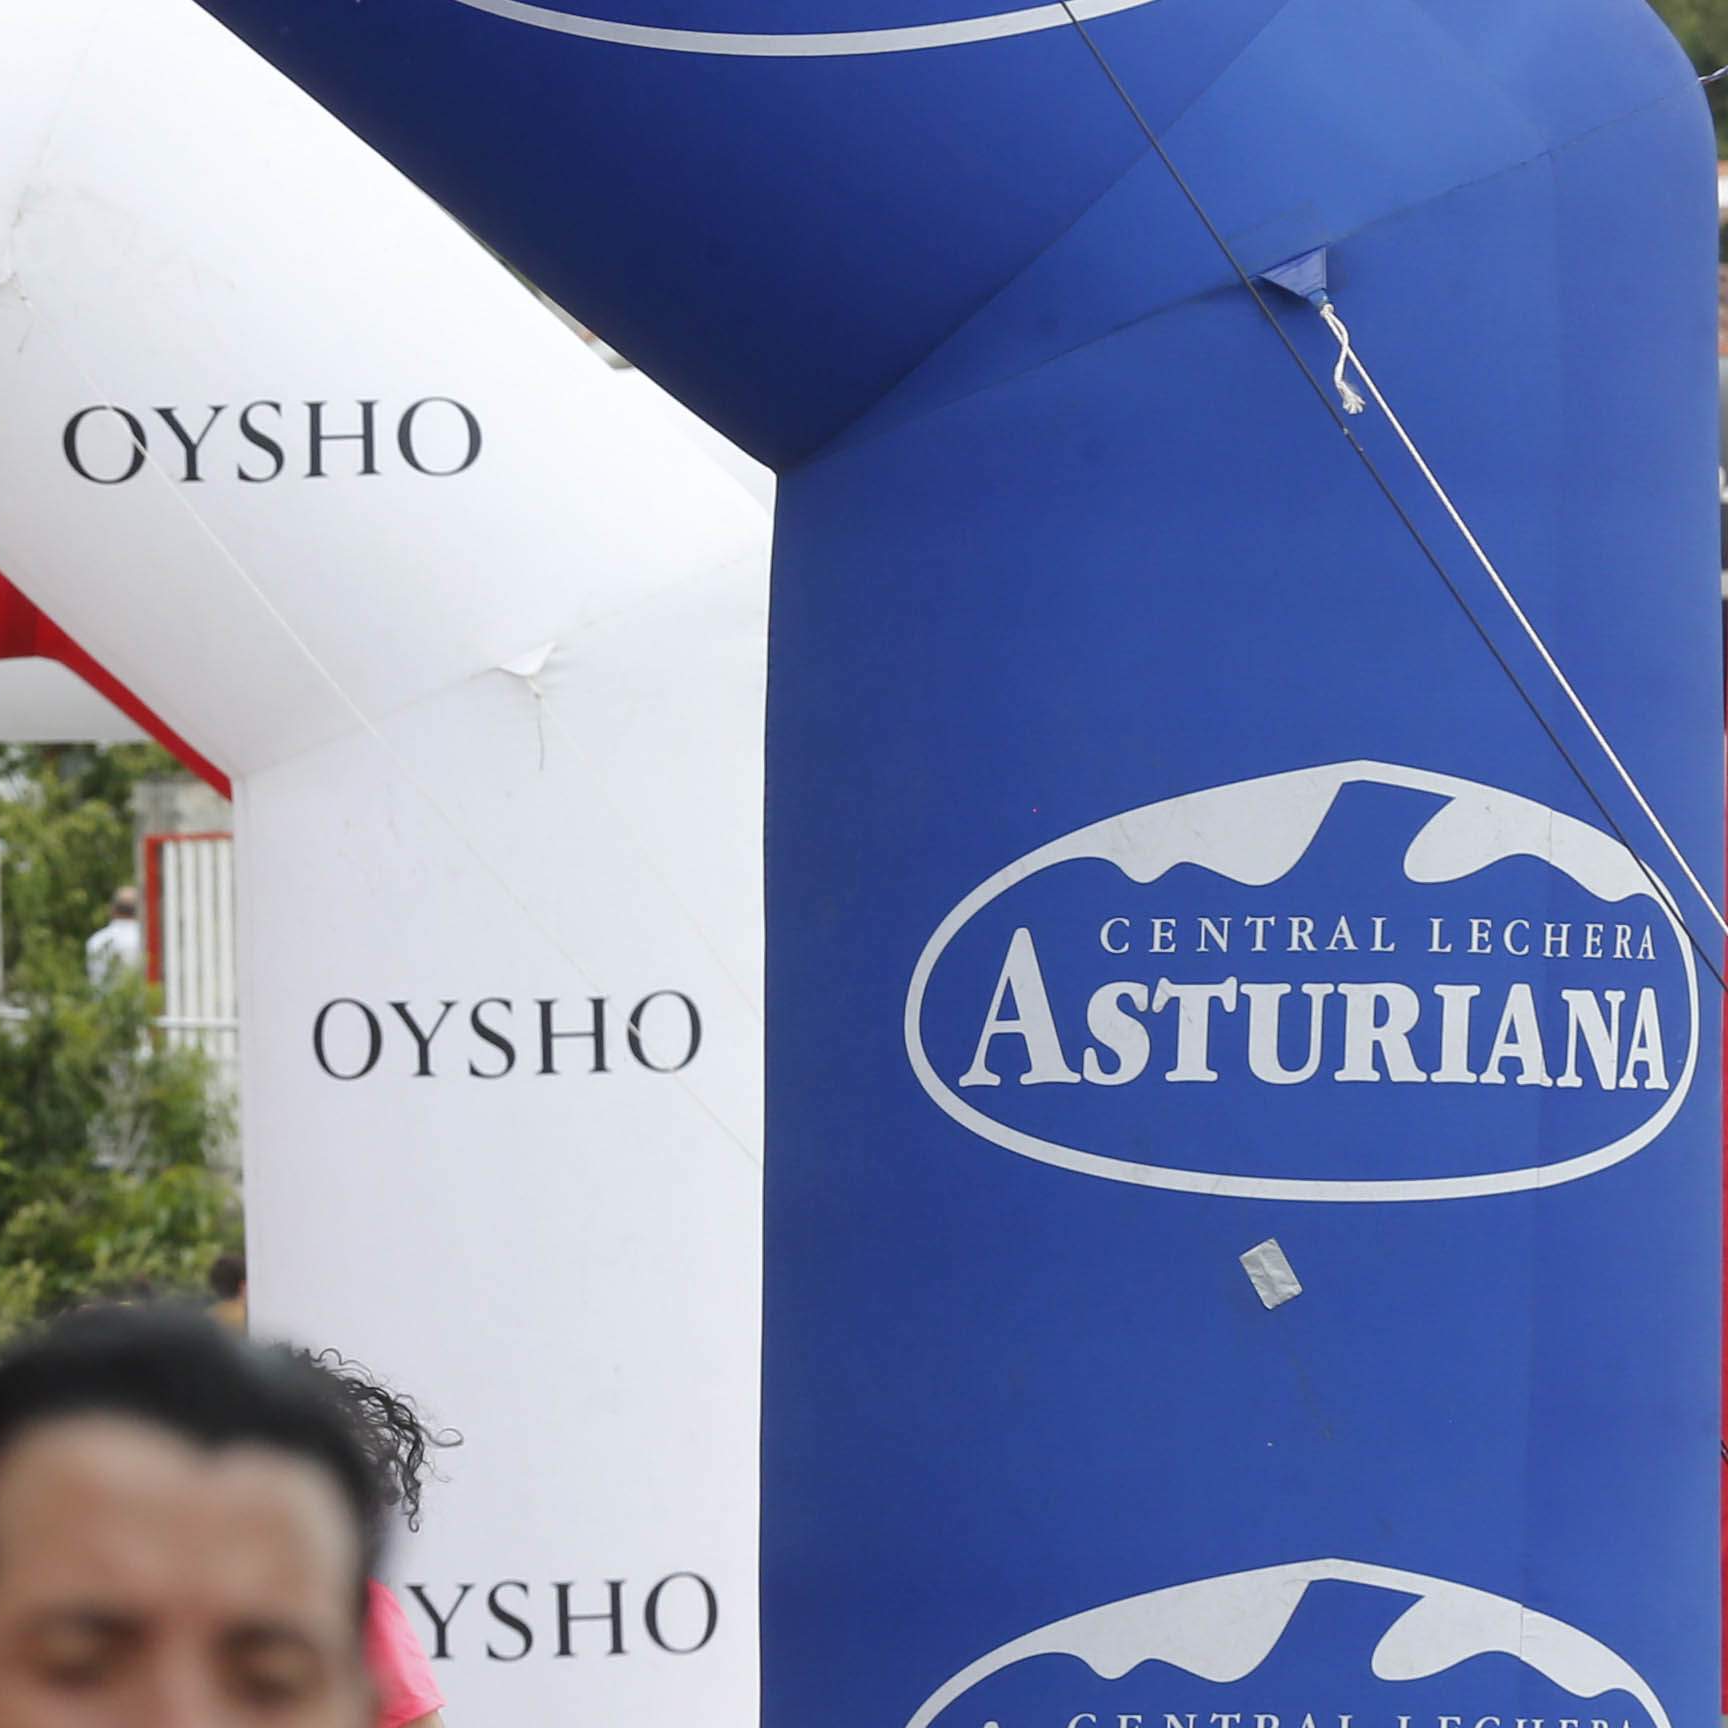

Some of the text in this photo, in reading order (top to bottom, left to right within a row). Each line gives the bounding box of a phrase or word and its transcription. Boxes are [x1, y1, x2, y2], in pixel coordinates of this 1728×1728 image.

[61, 397, 484, 486] OYSHO
[1099, 915, 1657, 961] CENTRAL LECHERA
[312, 989, 704, 1081] OYSHO
[959, 926, 1670, 1090] ASTURIANA
[406, 1571, 719, 1662] YSHO
